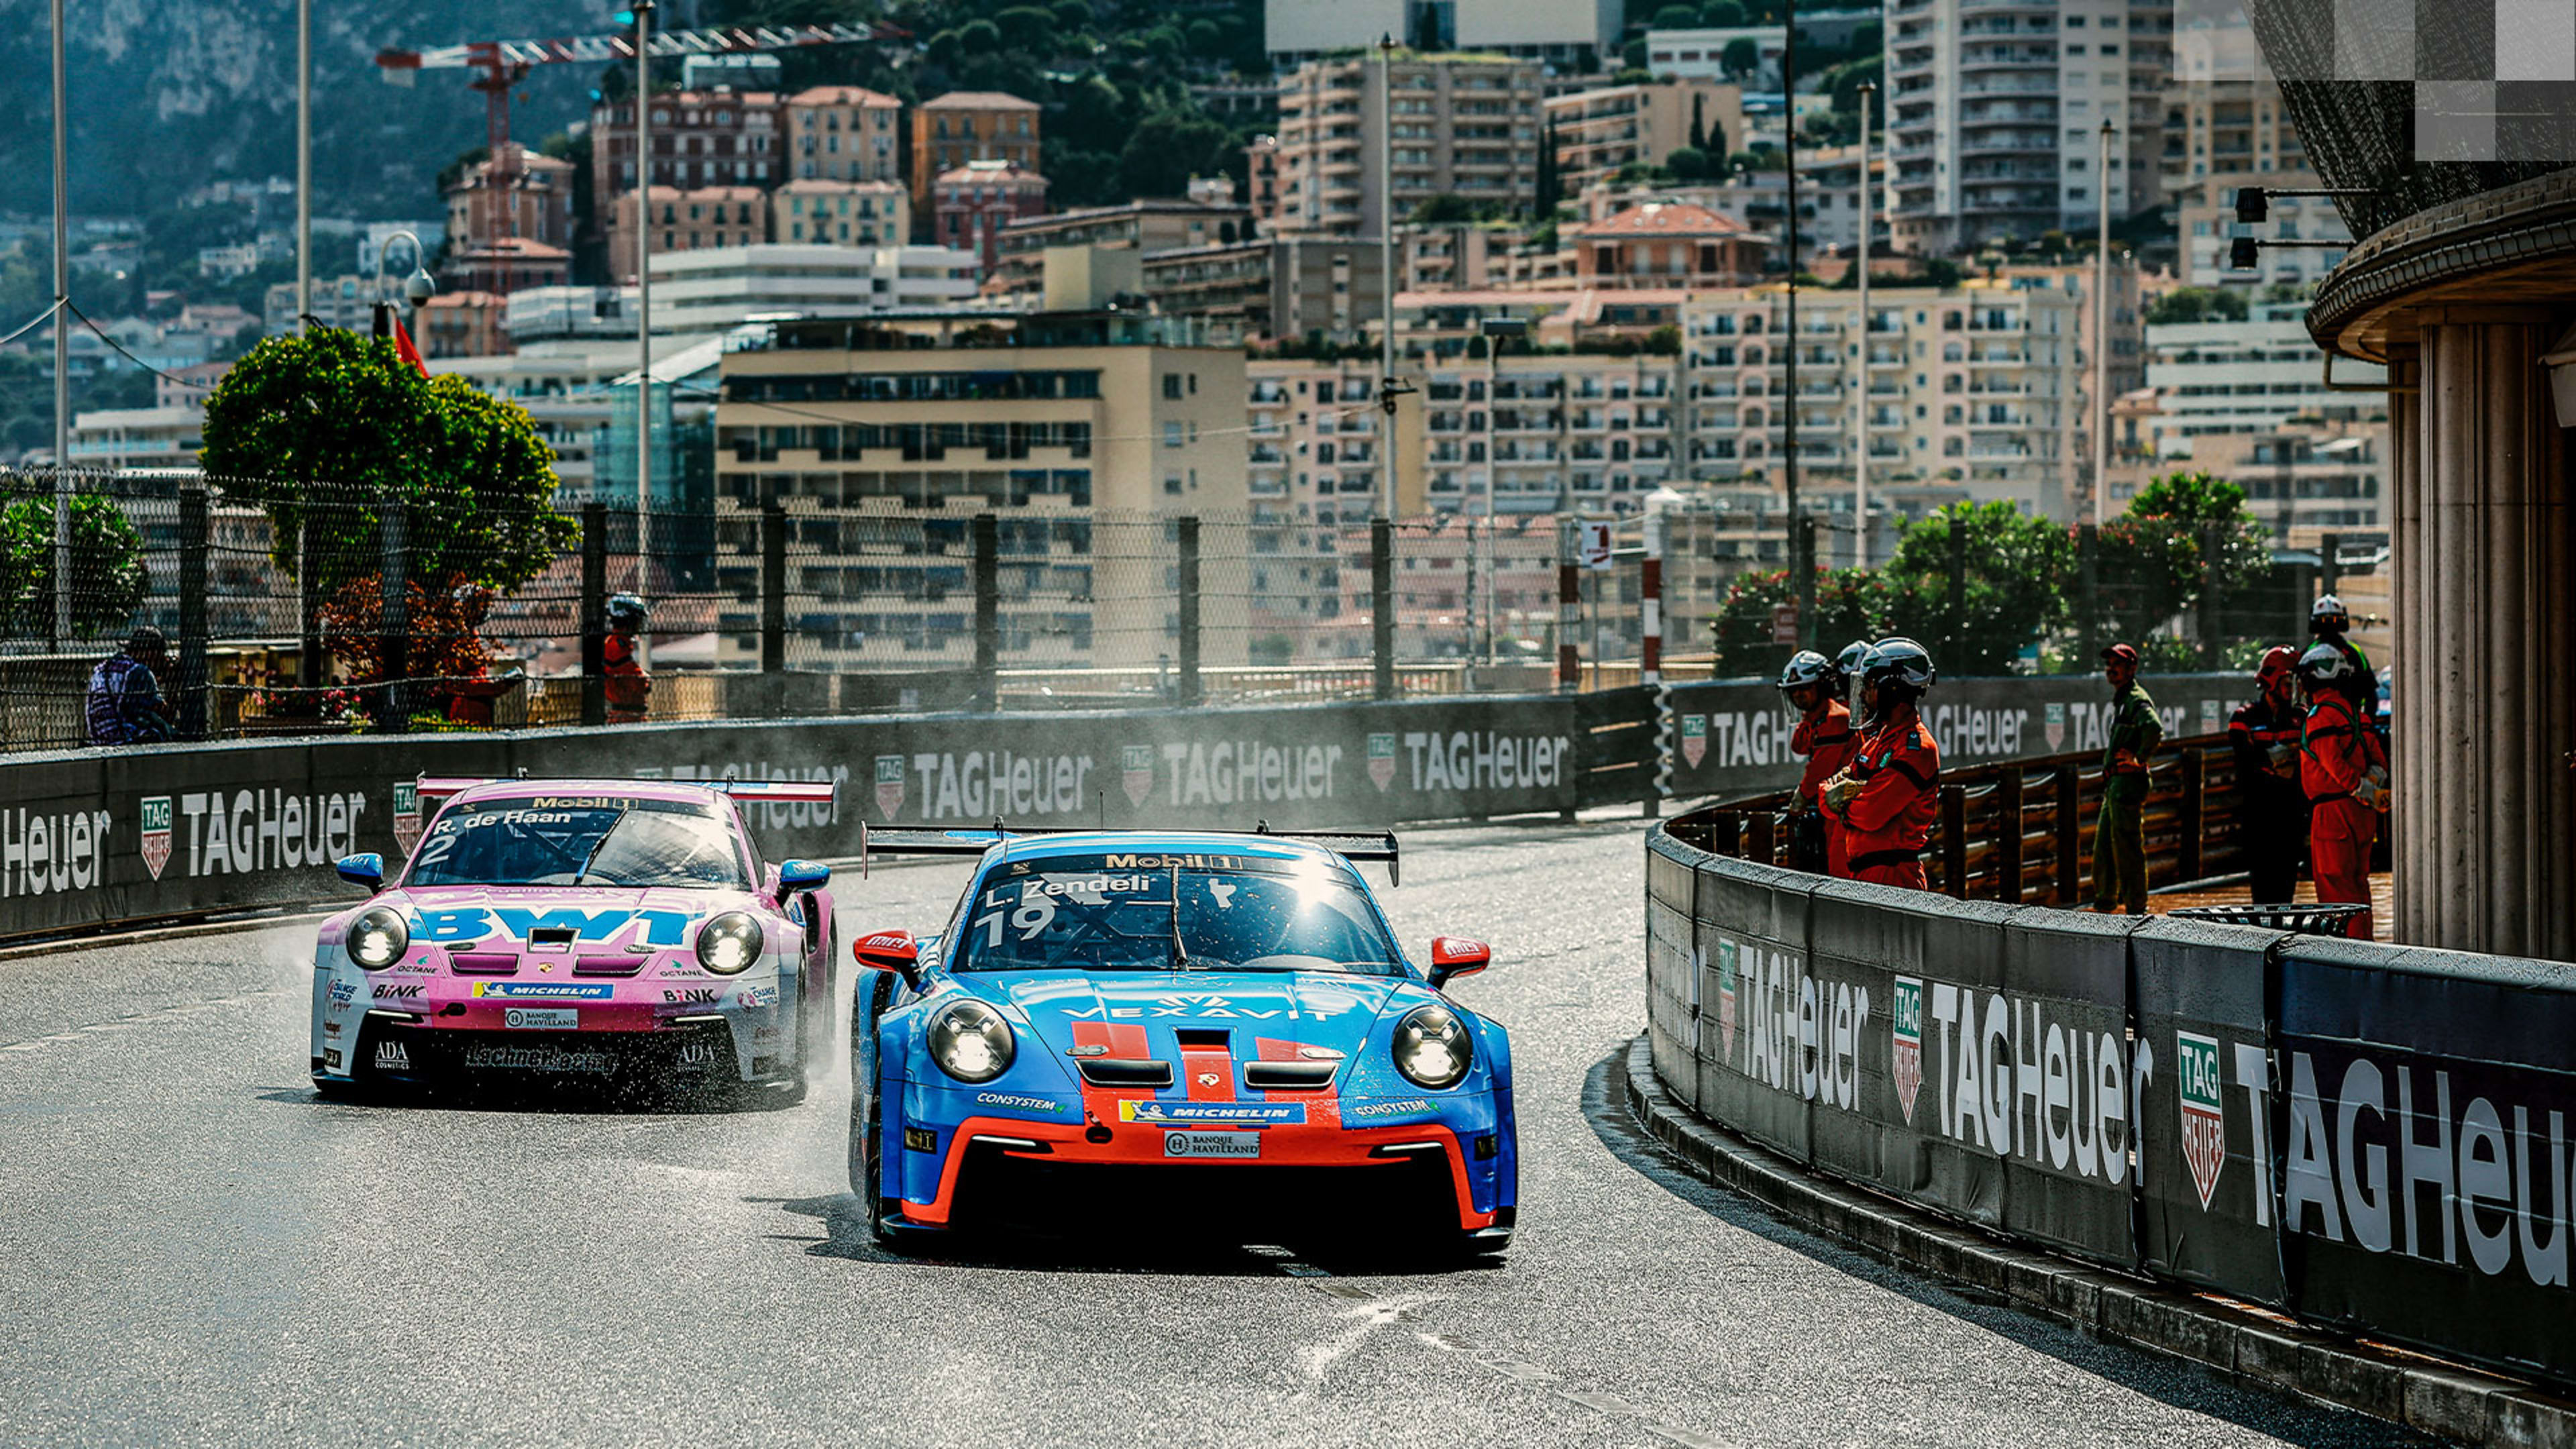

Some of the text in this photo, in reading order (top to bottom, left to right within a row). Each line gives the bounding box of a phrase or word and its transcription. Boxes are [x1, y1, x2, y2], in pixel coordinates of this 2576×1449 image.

[1713, 710, 1809, 767] TAGH
[879, 760, 902, 780] TAG
[532, 797, 608, 809] Mobil
[144, 802, 169, 826] TAG
[433, 819, 457, 836] R.
[464, 813, 497, 827] de
[503, 810, 572, 825] Haan
[3, 807, 111, 898] Heuer
[418, 835, 456, 867] 2
[1106, 854, 1205, 869] Mobil
[986, 875, 1149, 908] L. Zendeli
[408, 906, 706, 945] BWT
[975, 905, 1055, 948] 19
[398, 965, 437, 975] OCTANE
[512, 986, 602, 996] MICHELIN
[1061, 1006, 1340, 1021] VEXAVIT
[1896, 987, 1920, 1033] TAG
[527, 1019, 577, 1027] HAVILLAND
[375, 1040, 408, 1060] ADA
[677, 1044, 716, 1063] ADA
[2181, 1044, 2218, 1100] TAG
[977, 1092, 1057, 1110] CONSYSTEM
[1355, 1100, 1430, 1116] CONSYSTEM
[1173, 1109, 1290, 1118] MICHELIN
[1193, 1136, 1233, 1144] BANQUE
[1193, 1144, 1258, 1154] HAVILLAND
[2184, 1110, 2223, 1191] HEUER
[2235, 1042, 2576, 1288] TAGHeu
